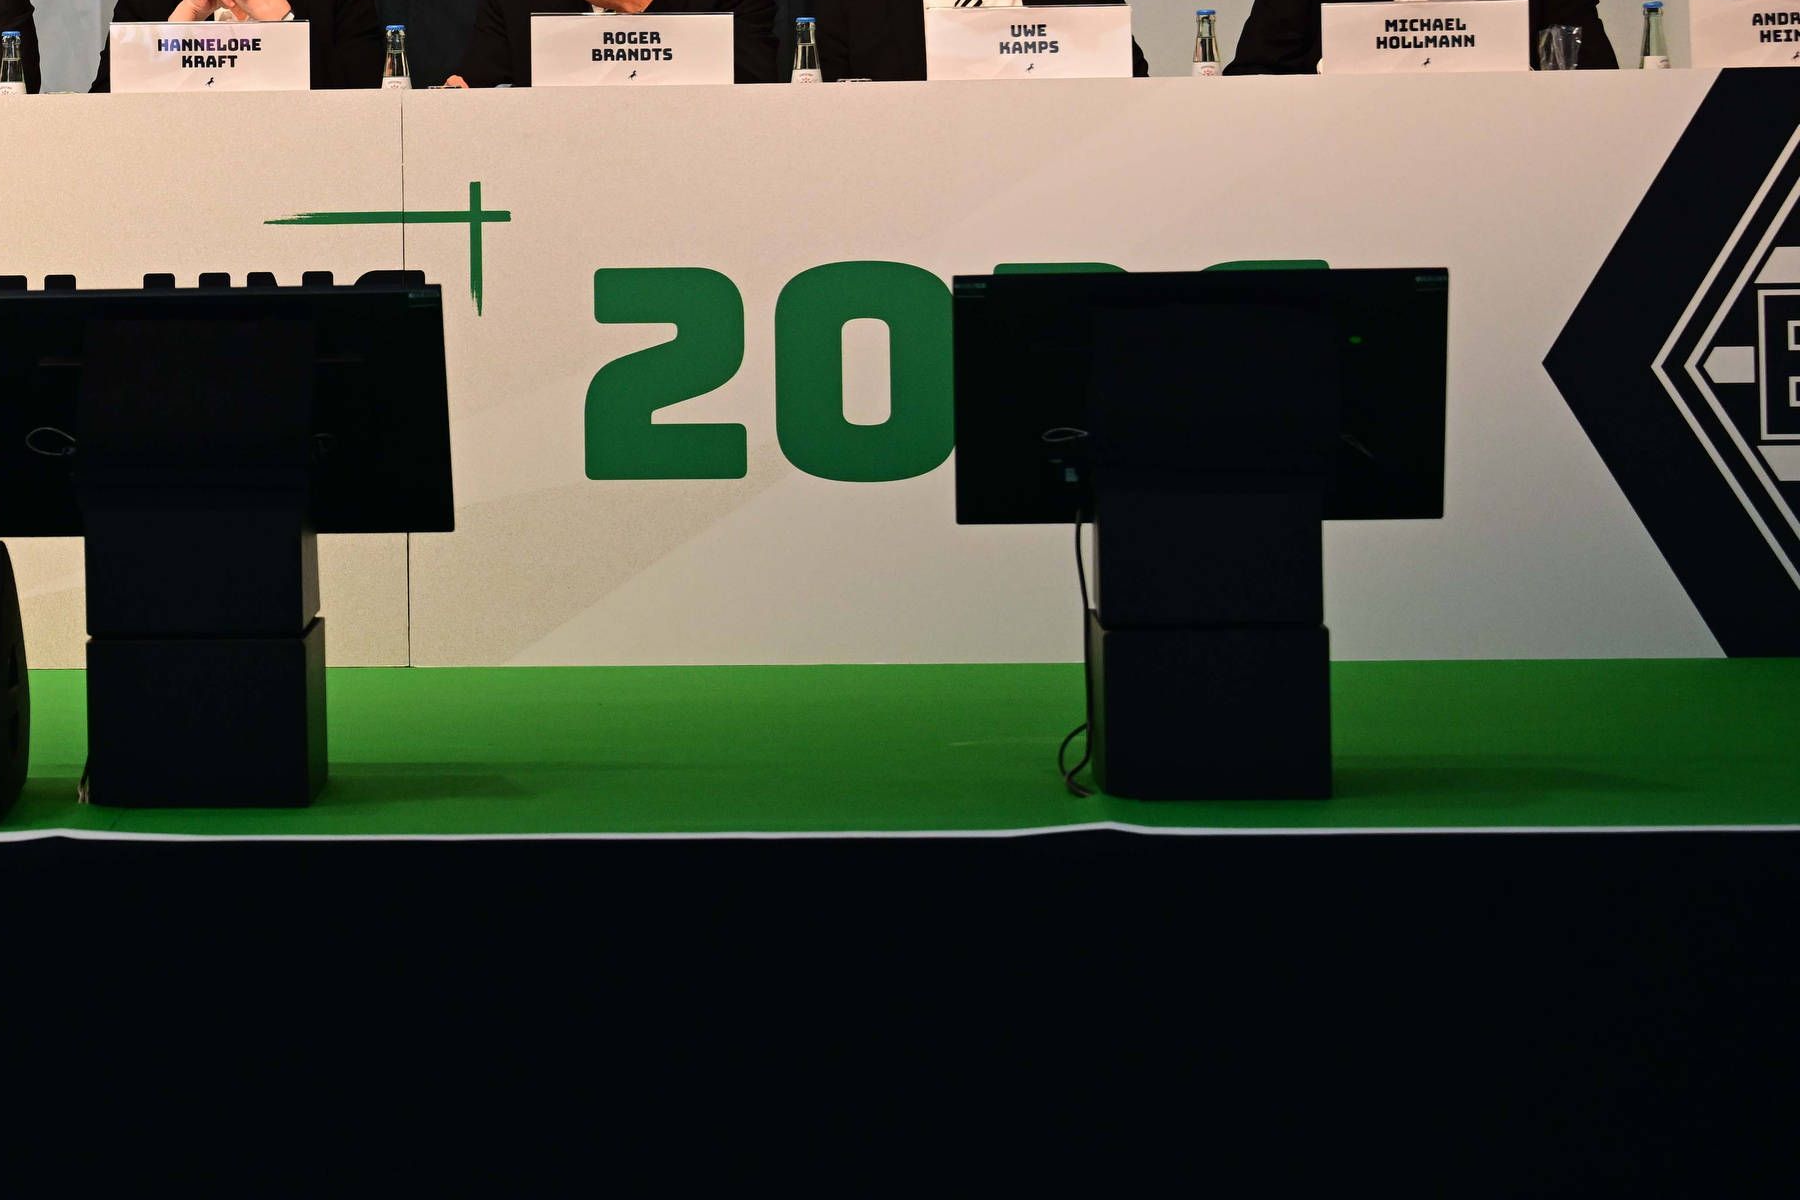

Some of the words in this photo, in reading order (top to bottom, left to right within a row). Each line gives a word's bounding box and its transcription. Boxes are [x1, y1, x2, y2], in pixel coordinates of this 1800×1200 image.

[1010, 23, 1047, 38] UWE
[1384, 17, 1467, 32] MICHAEL
[157, 38, 262, 52] HANNELORE
[602, 31, 662, 45] ROGER
[1375, 34, 1476, 49] HOLLMANN
[591, 47, 673, 62] BRANDTS
[999, 40, 1059, 55] KAMPS
[181, 54, 238, 69] KRAFT
